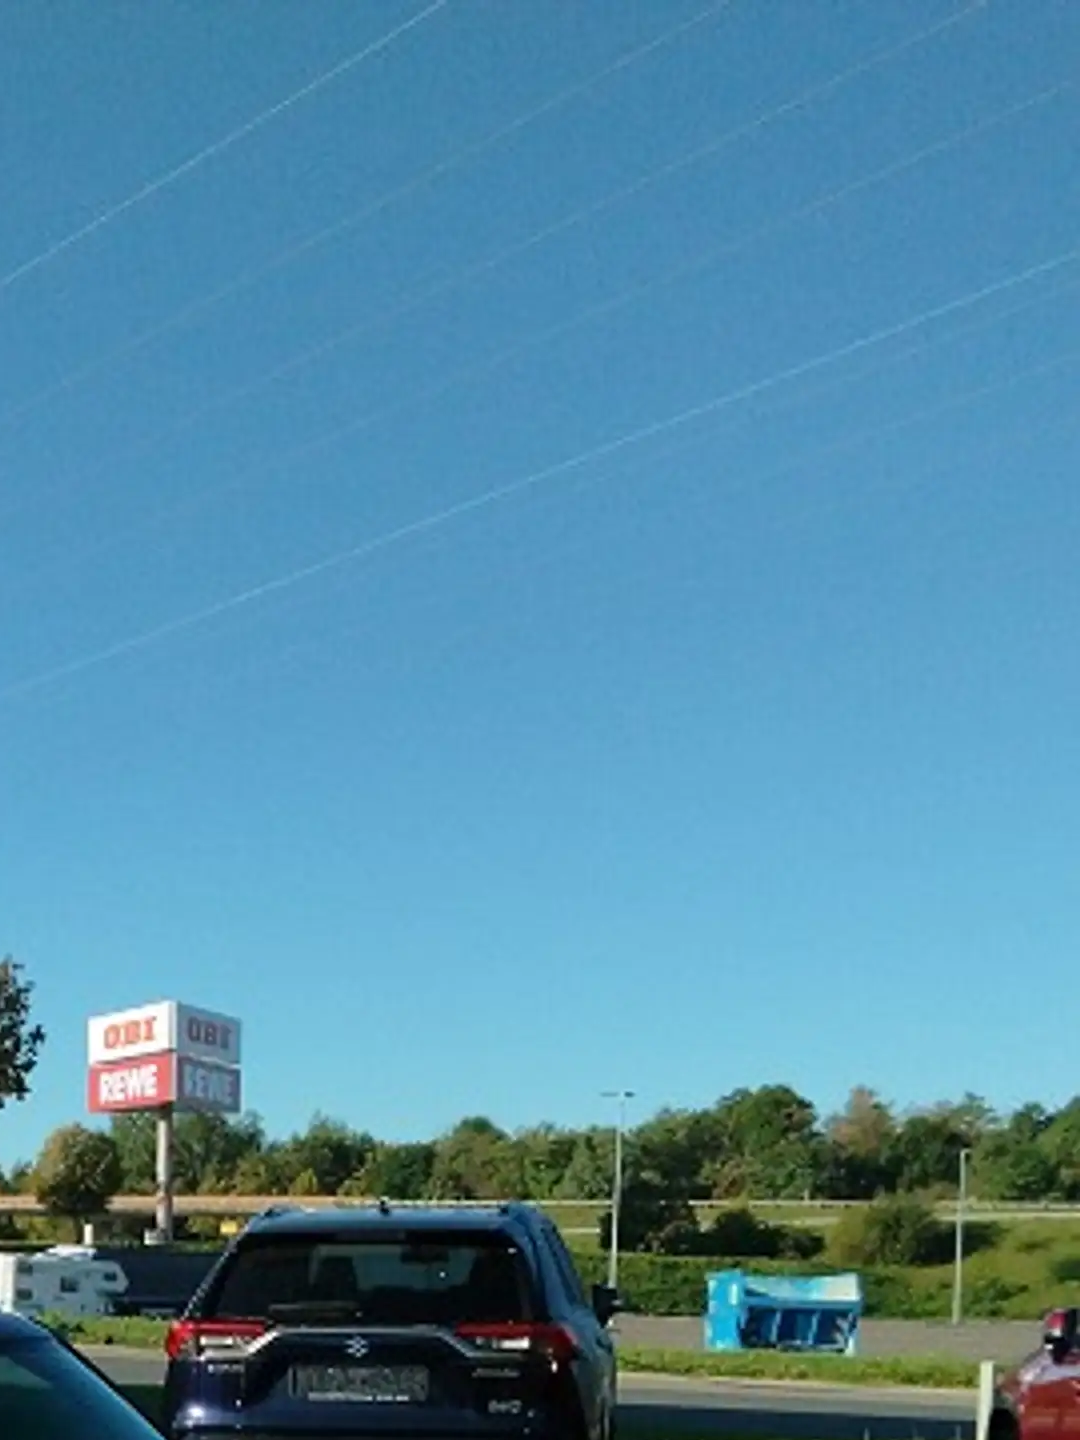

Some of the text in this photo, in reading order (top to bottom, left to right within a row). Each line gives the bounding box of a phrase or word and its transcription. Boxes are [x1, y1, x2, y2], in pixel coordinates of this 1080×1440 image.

[104, 1016, 157, 1050] OBI
[188, 1016, 232, 1050] OBI
[99, 1064, 158, 1106] REWE
